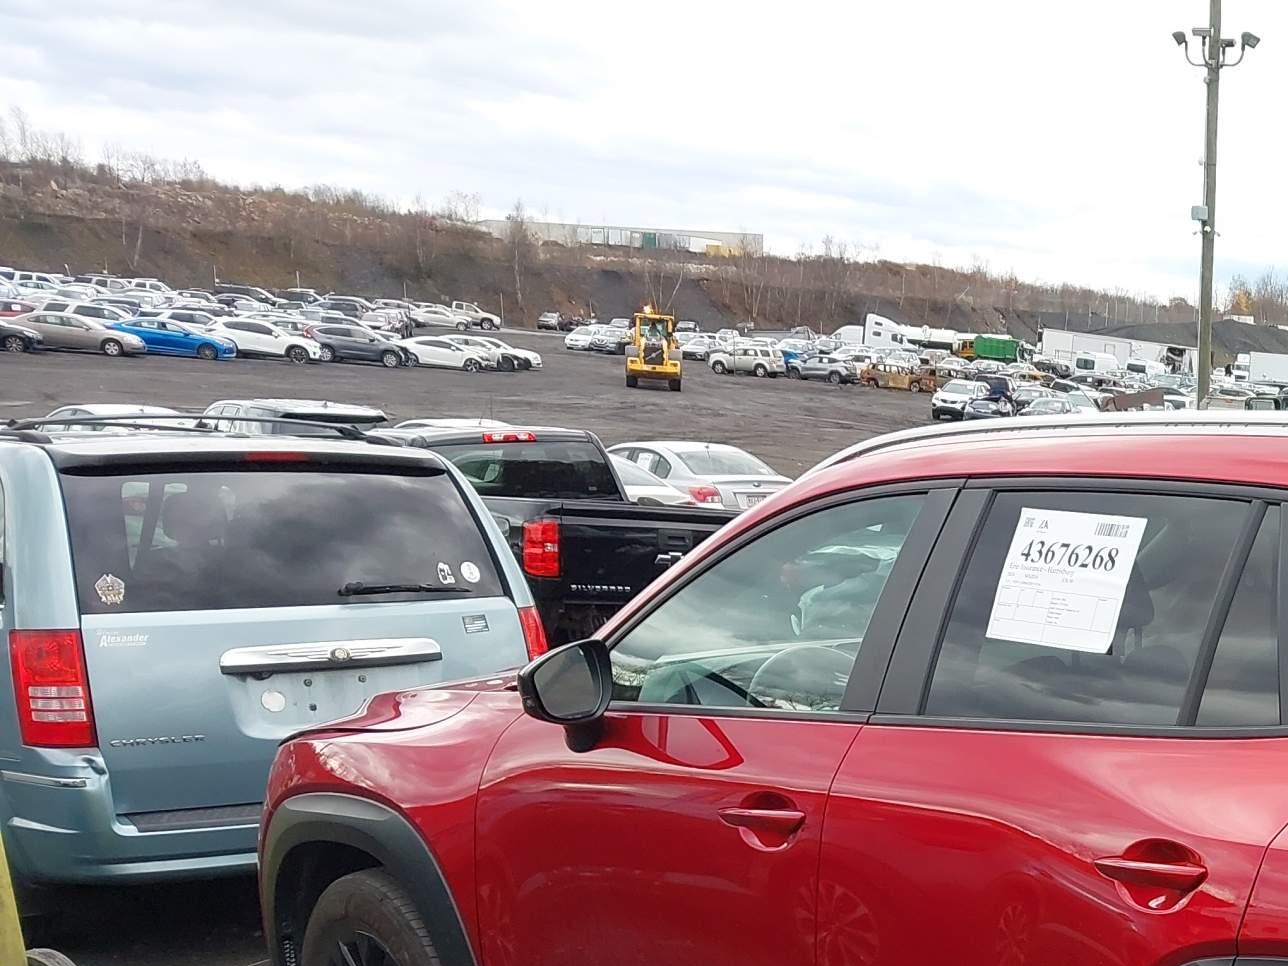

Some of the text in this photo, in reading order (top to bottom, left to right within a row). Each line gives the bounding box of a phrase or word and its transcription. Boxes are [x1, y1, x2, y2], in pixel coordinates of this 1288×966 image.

[1021, 539, 1119, 572] 43676268
[570, 584, 631, 592] SILVERADO
[110, 735, 206, 747] CHRYSLER
